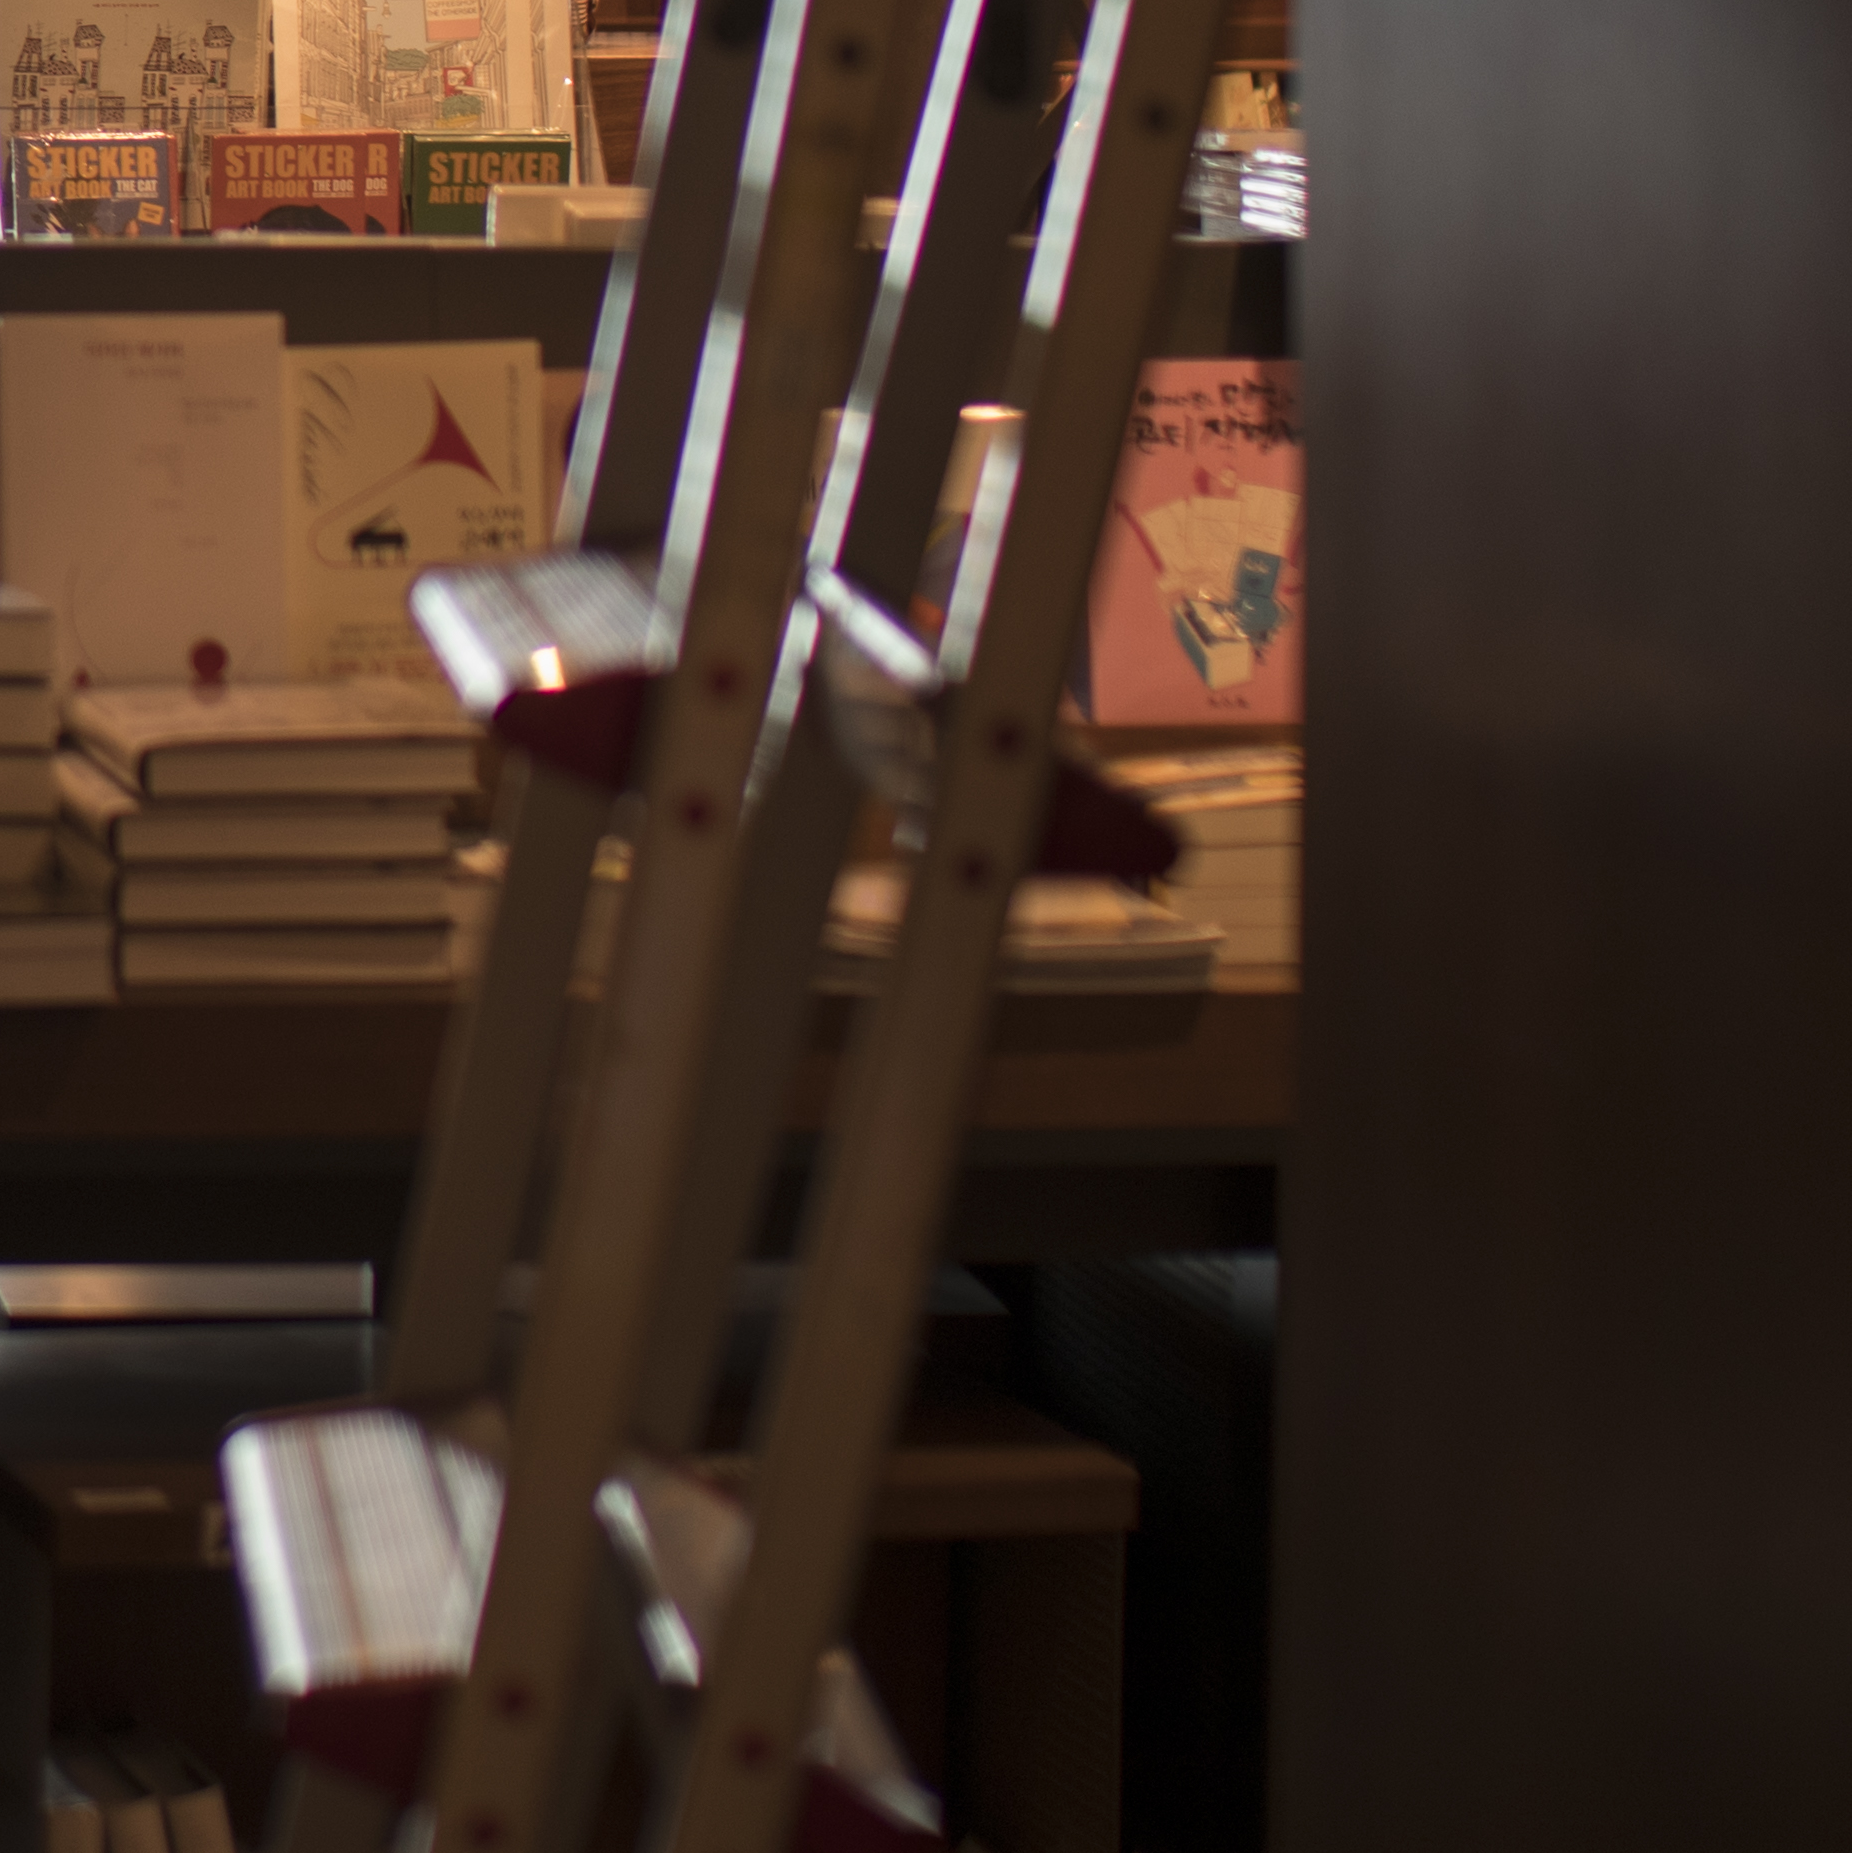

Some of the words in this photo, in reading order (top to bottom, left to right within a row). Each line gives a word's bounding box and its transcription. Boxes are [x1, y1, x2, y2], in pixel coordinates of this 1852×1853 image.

[27, 145, 158, 180] STICKER
[225, 144, 354, 178] STICKER
[428, 151, 561, 184] STICKER
[29, 180, 64, 199] ART
[65, 180, 113, 199] BOOK
[116, 179, 135, 192] THE
[137, 179, 158, 192] CAT
[226, 180, 259, 199] ART
[262, 180, 308, 199] BOOK
[312, 179, 329, 192] THE
[331, 179, 354, 193] DOG
[365, 178, 388, 191] DOG
[429, 186, 464, 204] ART
[467, 186, 487, 204] BO
